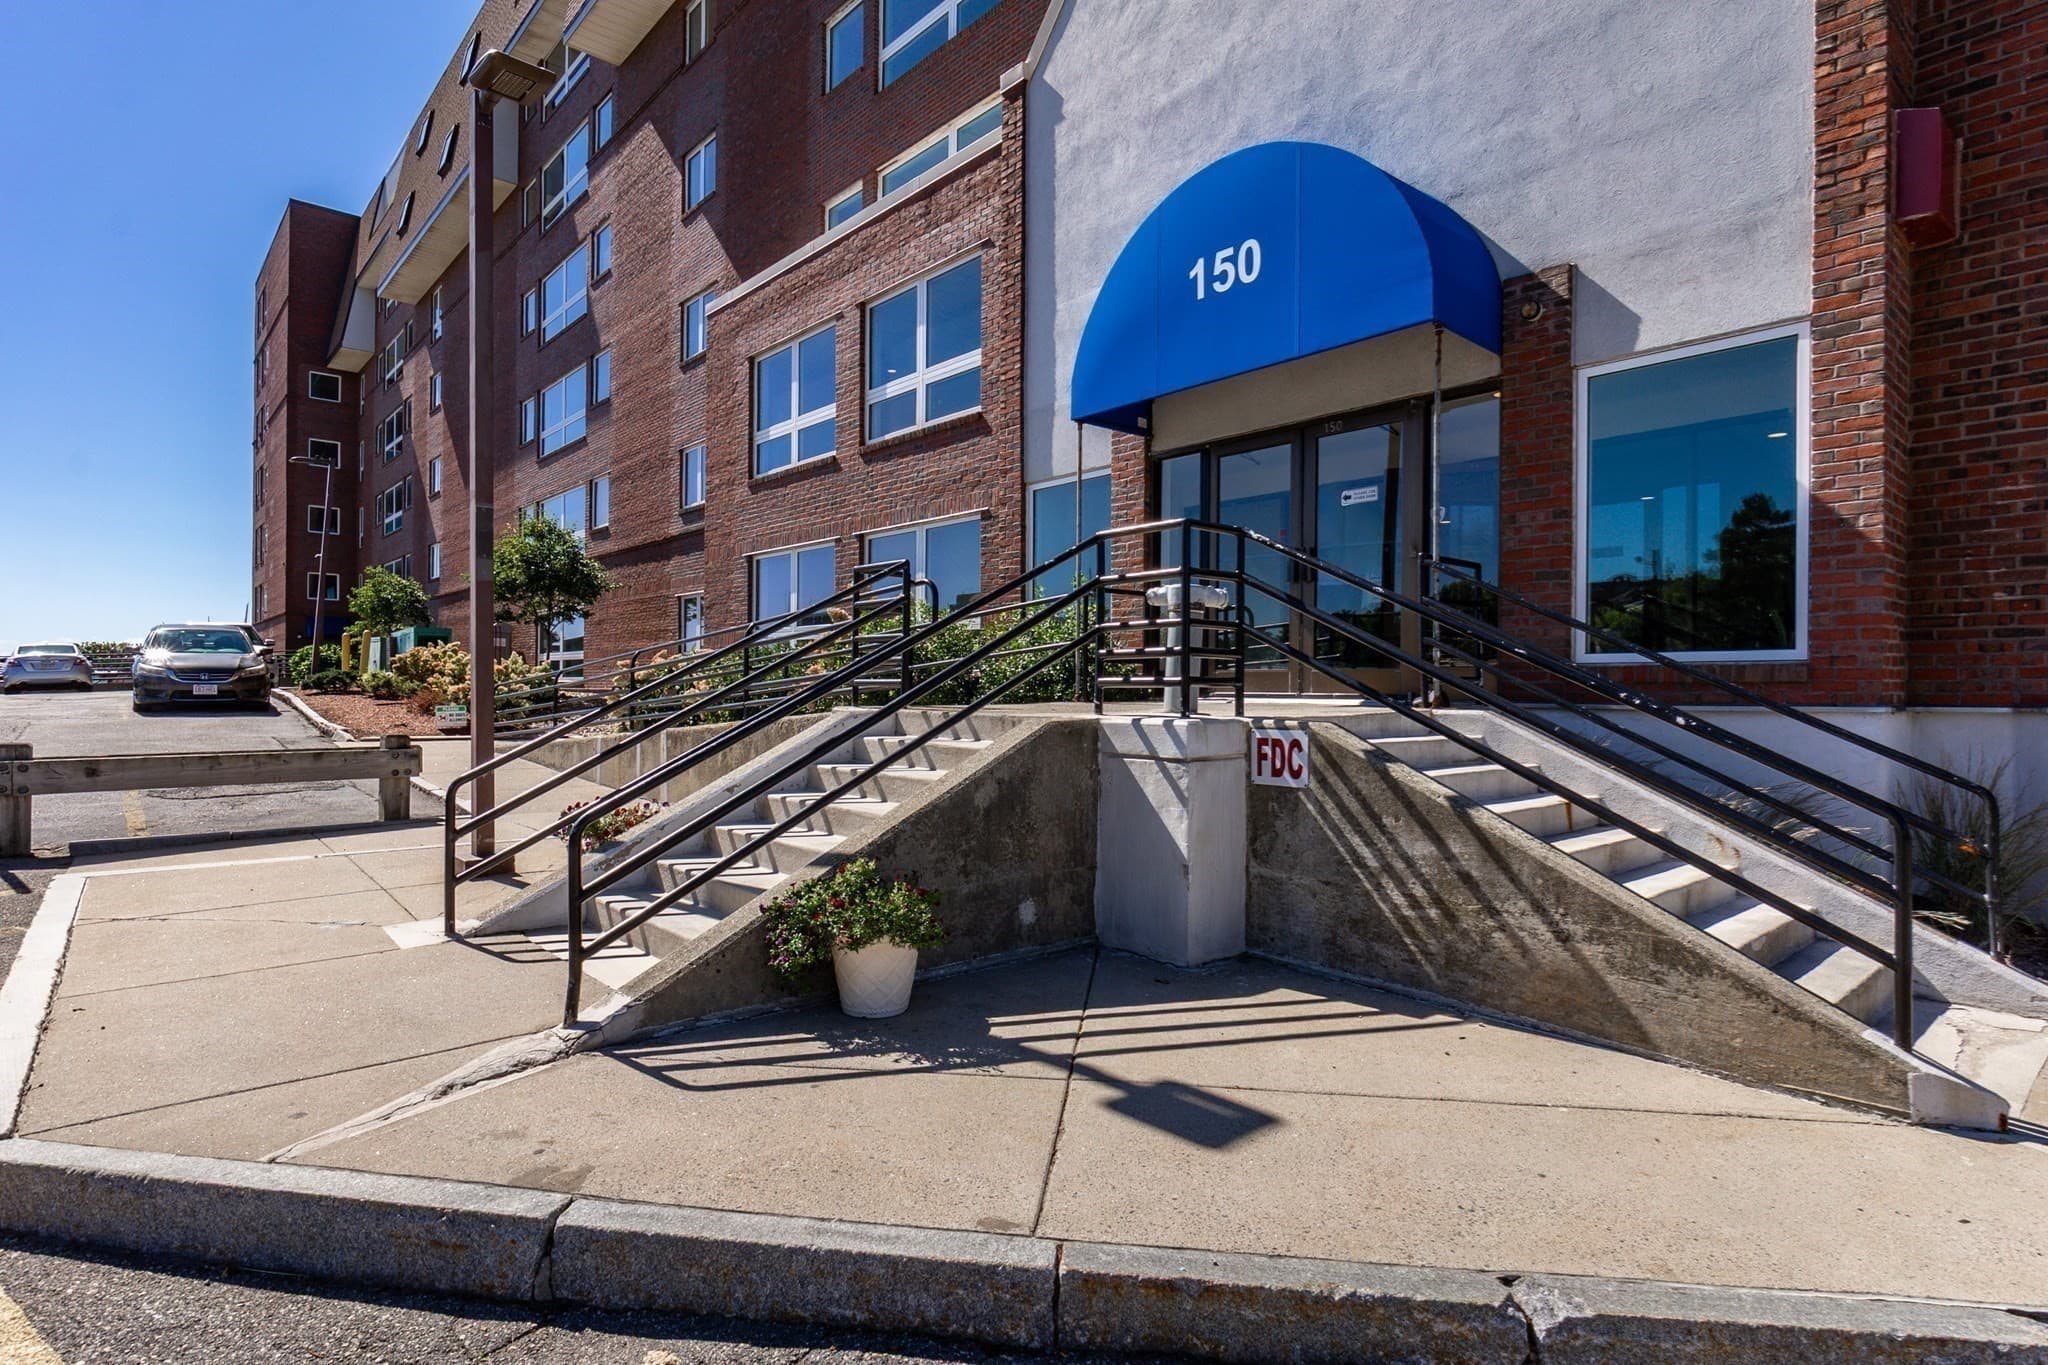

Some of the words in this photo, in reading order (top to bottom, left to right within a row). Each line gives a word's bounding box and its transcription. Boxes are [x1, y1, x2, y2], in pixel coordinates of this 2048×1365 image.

[1189, 238, 1261, 300] 150
[1324, 420, 1343, 433] 150
[1256, 736, 1304, 779] FDC
